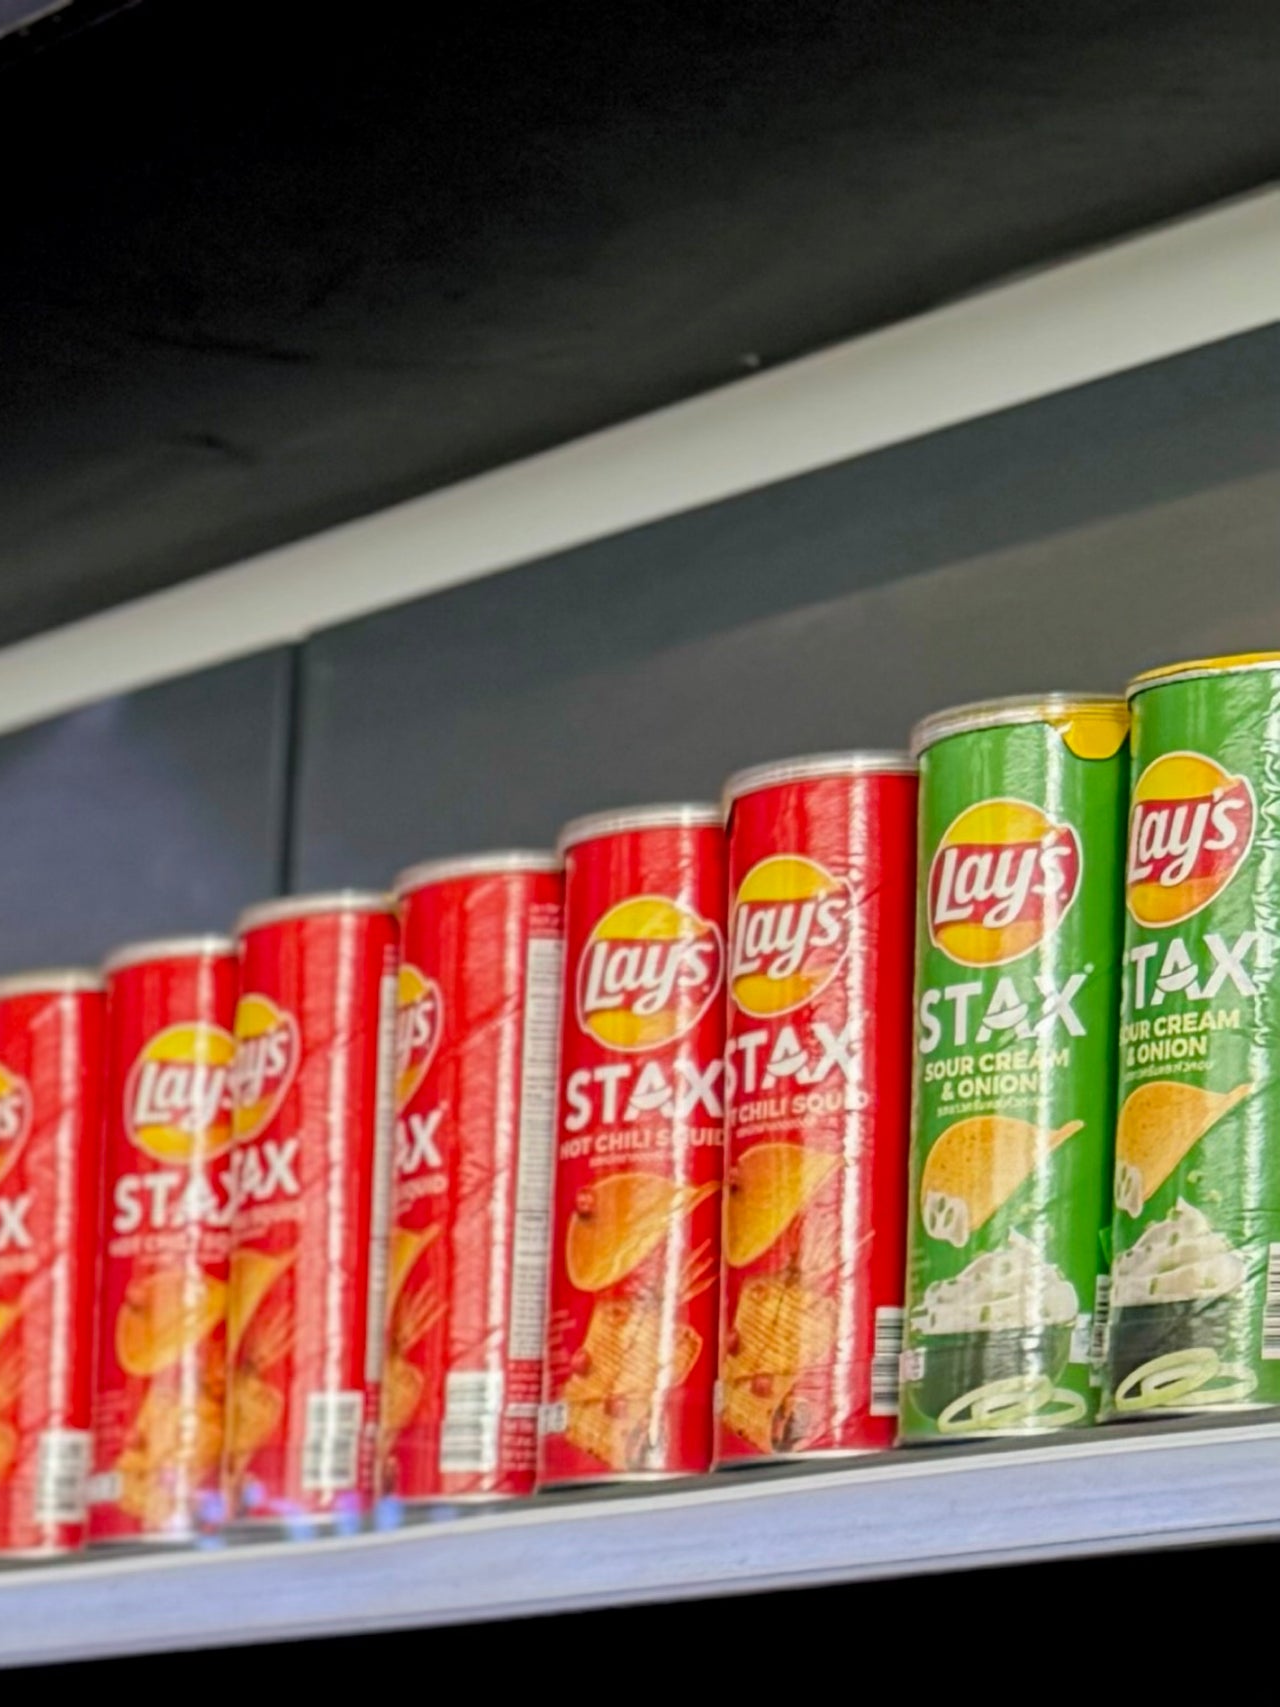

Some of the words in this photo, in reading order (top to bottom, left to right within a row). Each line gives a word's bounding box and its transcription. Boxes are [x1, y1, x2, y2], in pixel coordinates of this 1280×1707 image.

[1127, 786, 1244, 887] Lay's
[933, 829, 1072, 929] Lay's
[733, 890, 847, 980] Lay's
[919, 973, 1088, 1054] STAX
[1153, 1009, 1240, 1034] CREAM
[924, 1061, 974, 1083] SOUR
[978, 1047, 1070, 1072] CREAM
[1137, 1035, 1208, 1063] ONION
[134, 1060, 236, 1136] Lay
[564, 1059, 725, 1132] STAX
[736, 1095, 788, 1124] CHILI
[941, 1081, 954, 1101] &
[956, 1073, 1039, 1096] ONION
[595, 1129, 651, 1155] CHILI
